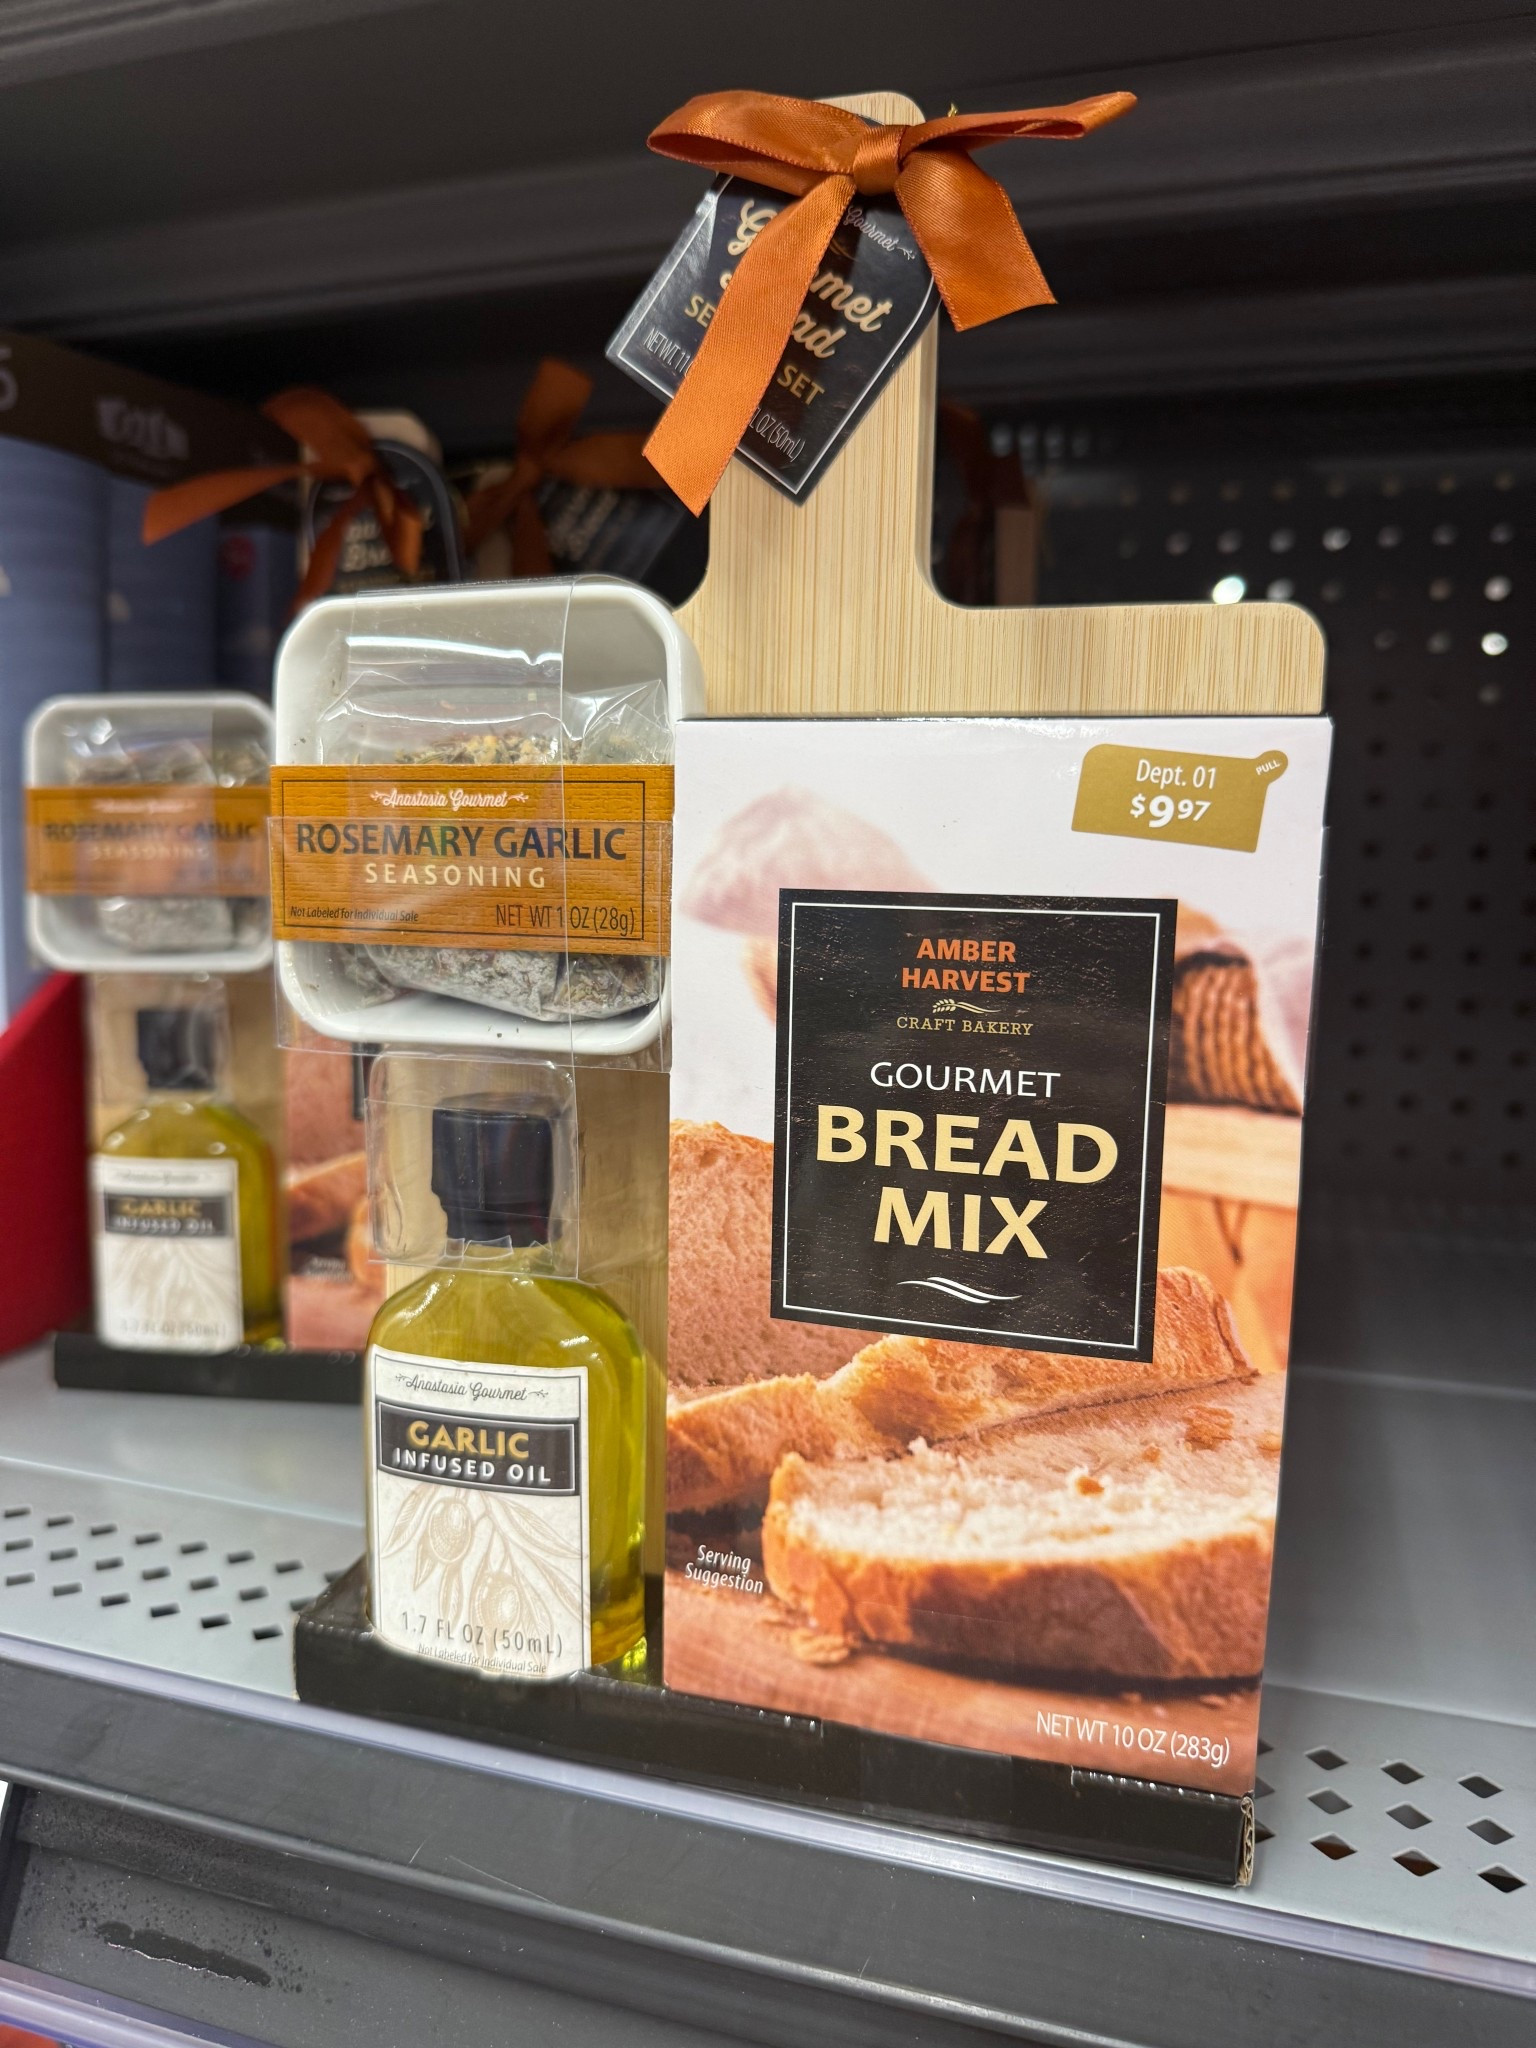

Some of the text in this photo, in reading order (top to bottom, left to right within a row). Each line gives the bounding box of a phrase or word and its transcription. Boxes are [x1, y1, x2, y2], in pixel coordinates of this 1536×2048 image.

[843, 205, 899, 252] Gourmet
[777, 364, 825, 405] SET
[755, 414, 776, 438] OZ
[768, 422, 805, 462] (50mL)
[1135, 758, 1216, 789] Dept. 01
[1255, 759, 1281, 776] PULL
[382, 787, 508, 811] Anastasia Gourmet
[297, 823, 627, 860] ROSEMARY GARLIC
[366, 863, 545, 888] SEASONING
[290, 905, 419, 922] Not Labeled for Individual Sale
[496, 904, 522, 926] NET
[529, 905, 552, 928] WT
[570, 906, 590, 929] OZ
[593, 907, 635, 937] (28g)
[916, 938, 1016, 963] AMBER
[902, 967, 1031, 994] HARVEST
[896, 1016, 1033, 1036] CRAFT BAKERY
[870, 1061, 1061, 1098] GOURMET
[816, 1104, 1119, 1184] BREAD
[873, 1186, 1048, 1260] MIX
[406, 1374, 528, 1401] Anastasia Gourmet
[408, 1420, 529, 1460] GARLIC
[392, 1447, 551, 1484] INFUSED OIL
[697, 1544, 751, 1574] Serving
[685, 1562, 764, 1594] Suggestion
[402, 1611, 562, 1658] 1.7 FL OZ (50mL)
[434, 1646, 467, 1664] Labeled
[468, 1654, 480, 1665] for
[482, 1656, 526, 1672] Individual
[527, 1661, 547, 1674] Sale
[1036, 1710, 1230, 1768] NET WT 10 OZ (283g)
